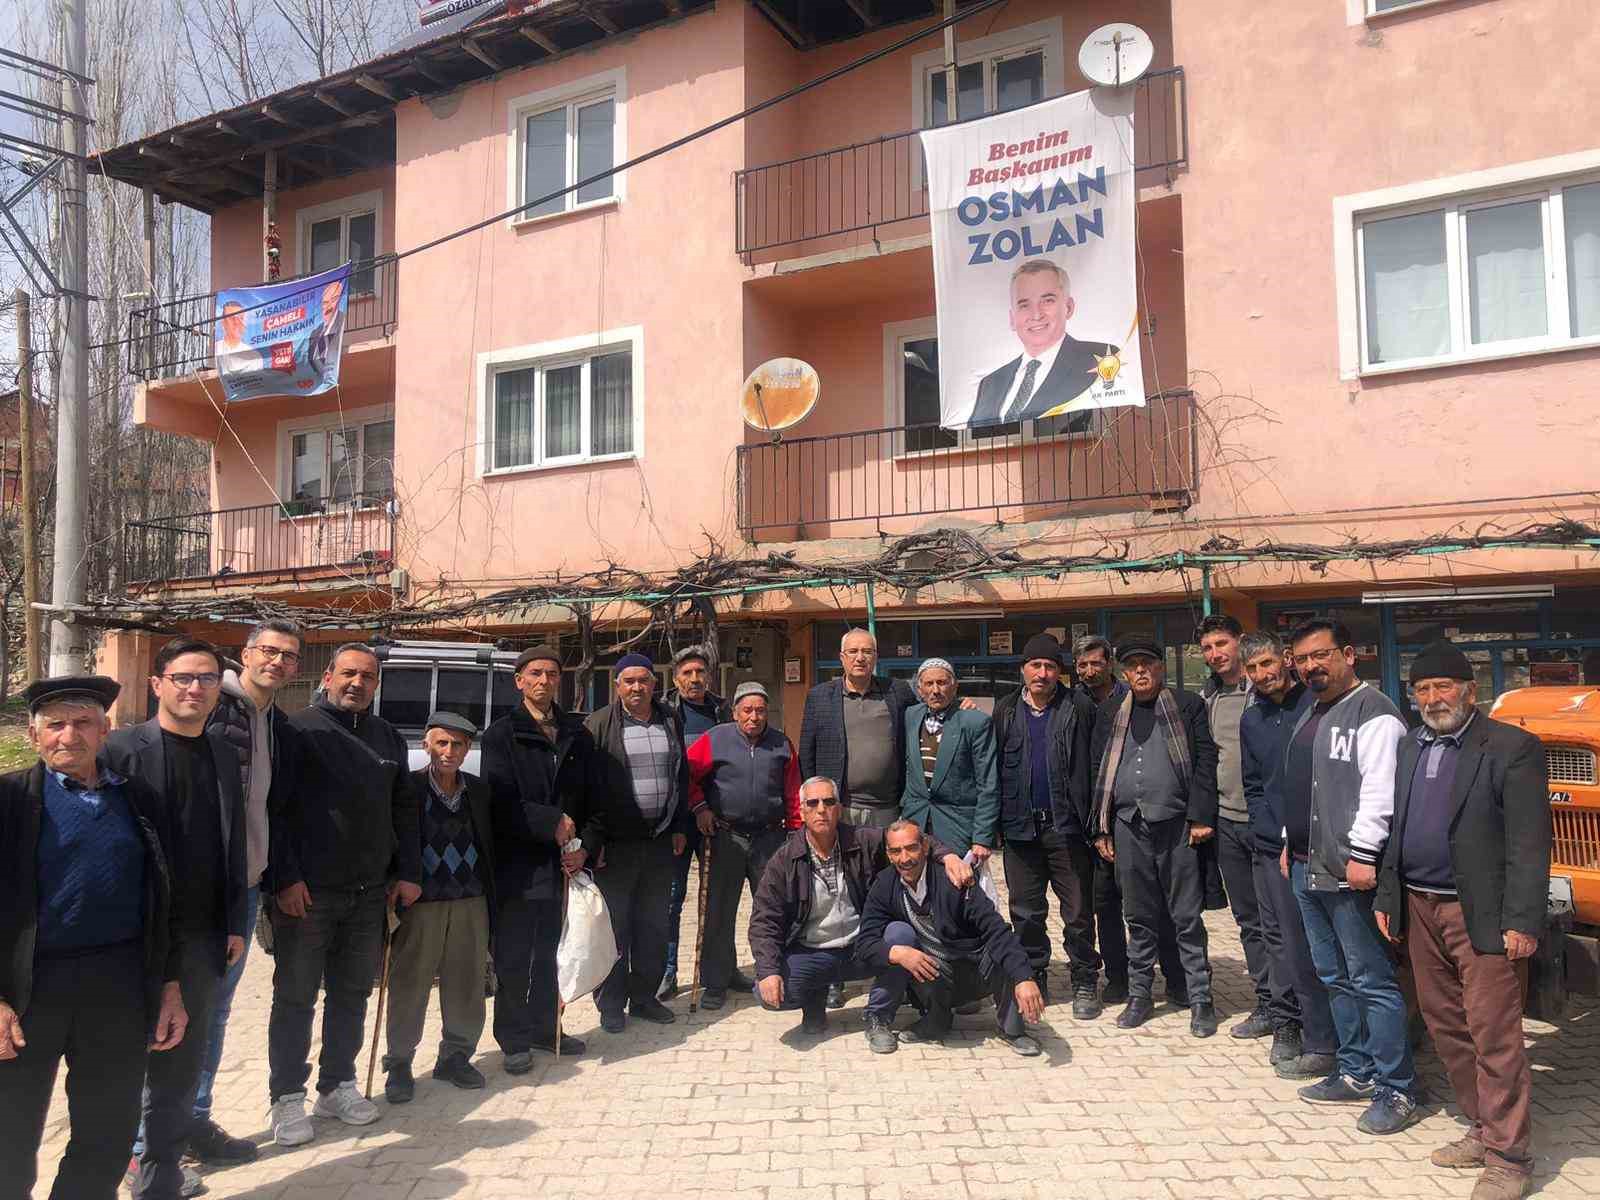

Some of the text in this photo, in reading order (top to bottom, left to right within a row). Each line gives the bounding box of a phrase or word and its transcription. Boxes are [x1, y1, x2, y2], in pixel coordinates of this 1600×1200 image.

[967, 143, 1093, 186] Başkanım
[987, 128, 1069, 162] Benim
[957, 166, 1107, 227] OSMAN
[968, 208, 1104, 266] ZOLAN
[1329, 726, 1355, 762] W
